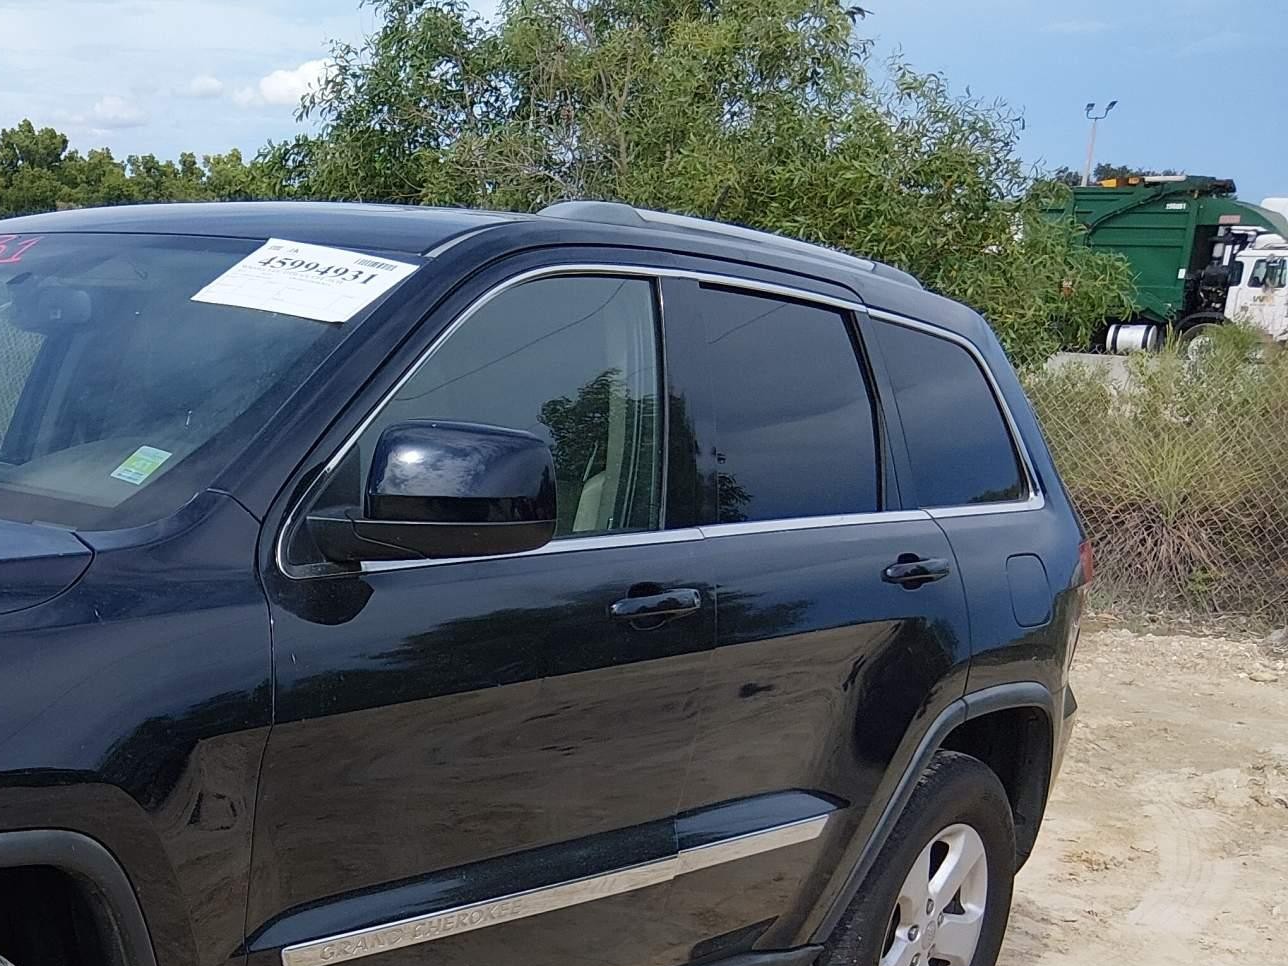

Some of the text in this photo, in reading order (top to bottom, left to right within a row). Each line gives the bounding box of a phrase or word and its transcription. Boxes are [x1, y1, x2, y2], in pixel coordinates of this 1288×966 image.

[258, 256, 379, 284] 45994931
[319, 898, 523, 961] GRAND CHEROKEE
